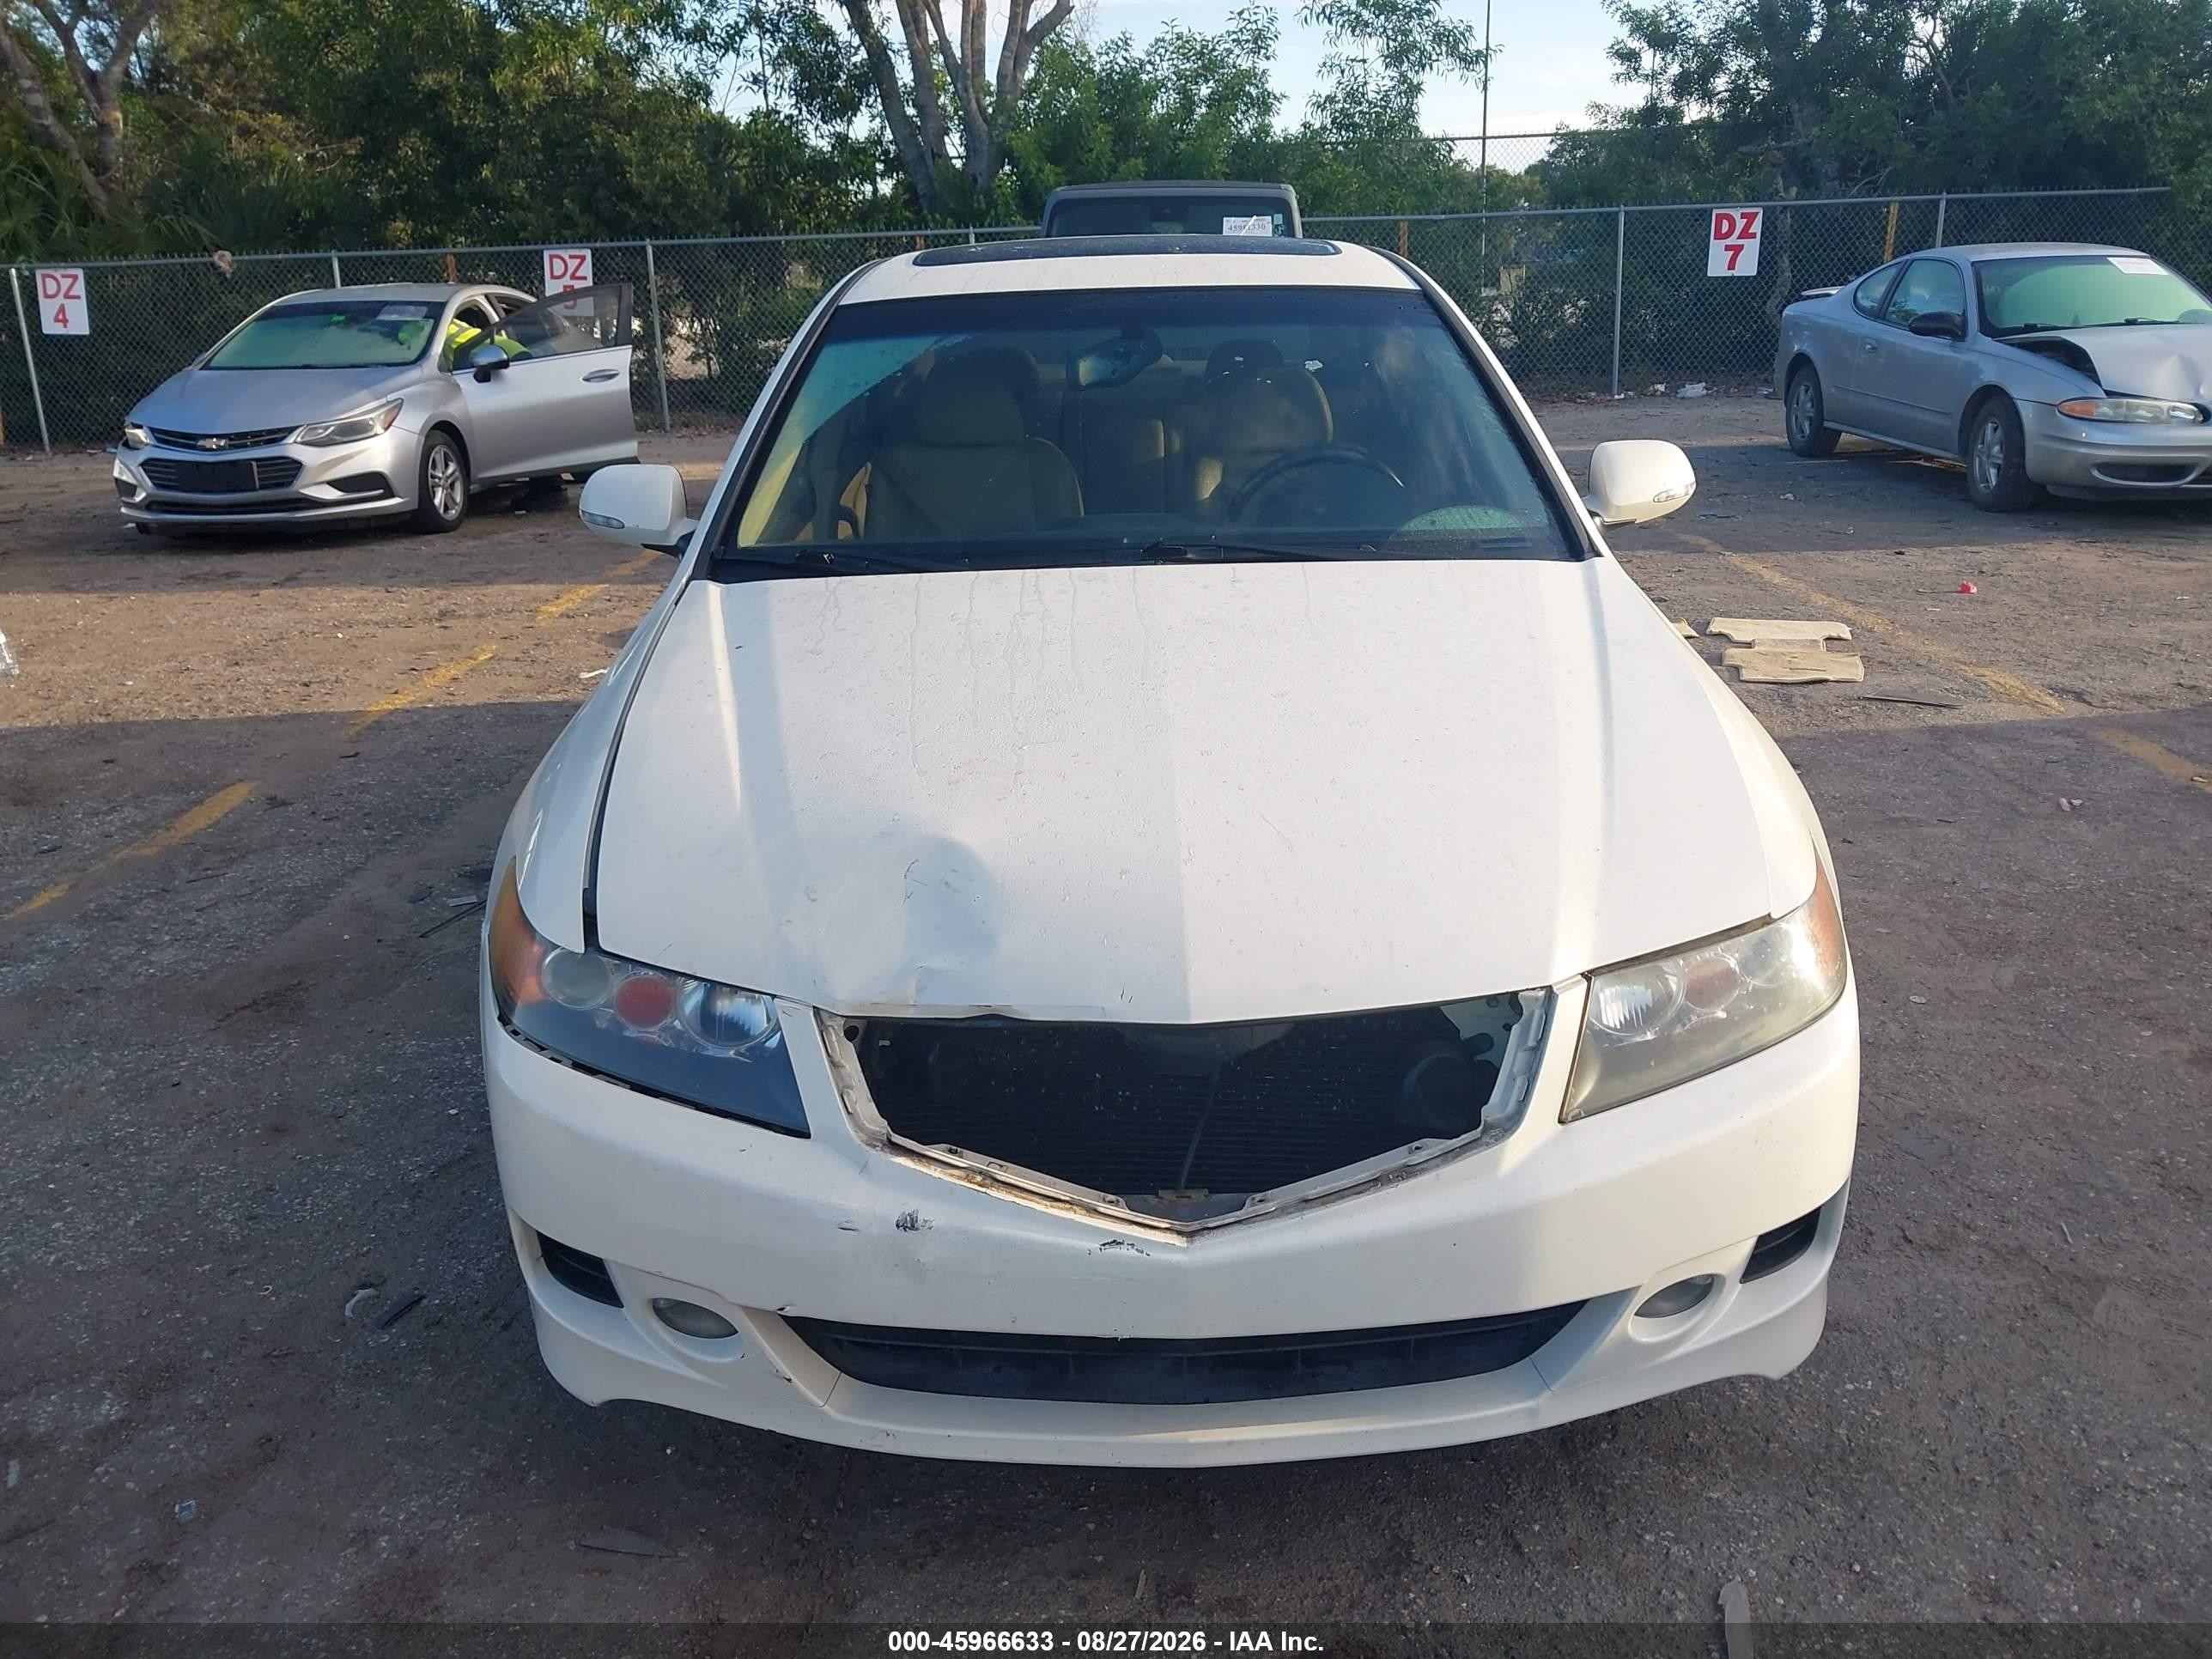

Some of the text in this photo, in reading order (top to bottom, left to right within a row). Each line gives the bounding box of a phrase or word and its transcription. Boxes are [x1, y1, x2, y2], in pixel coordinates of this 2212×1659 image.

[1713, 211, 1760, 240] DZ
[548, 253, 588, 281] DZ
[1723, 243, 1745, 270] 7
[40, 273, 82, 300] DZ
[53, 303, 69, 329] 4
